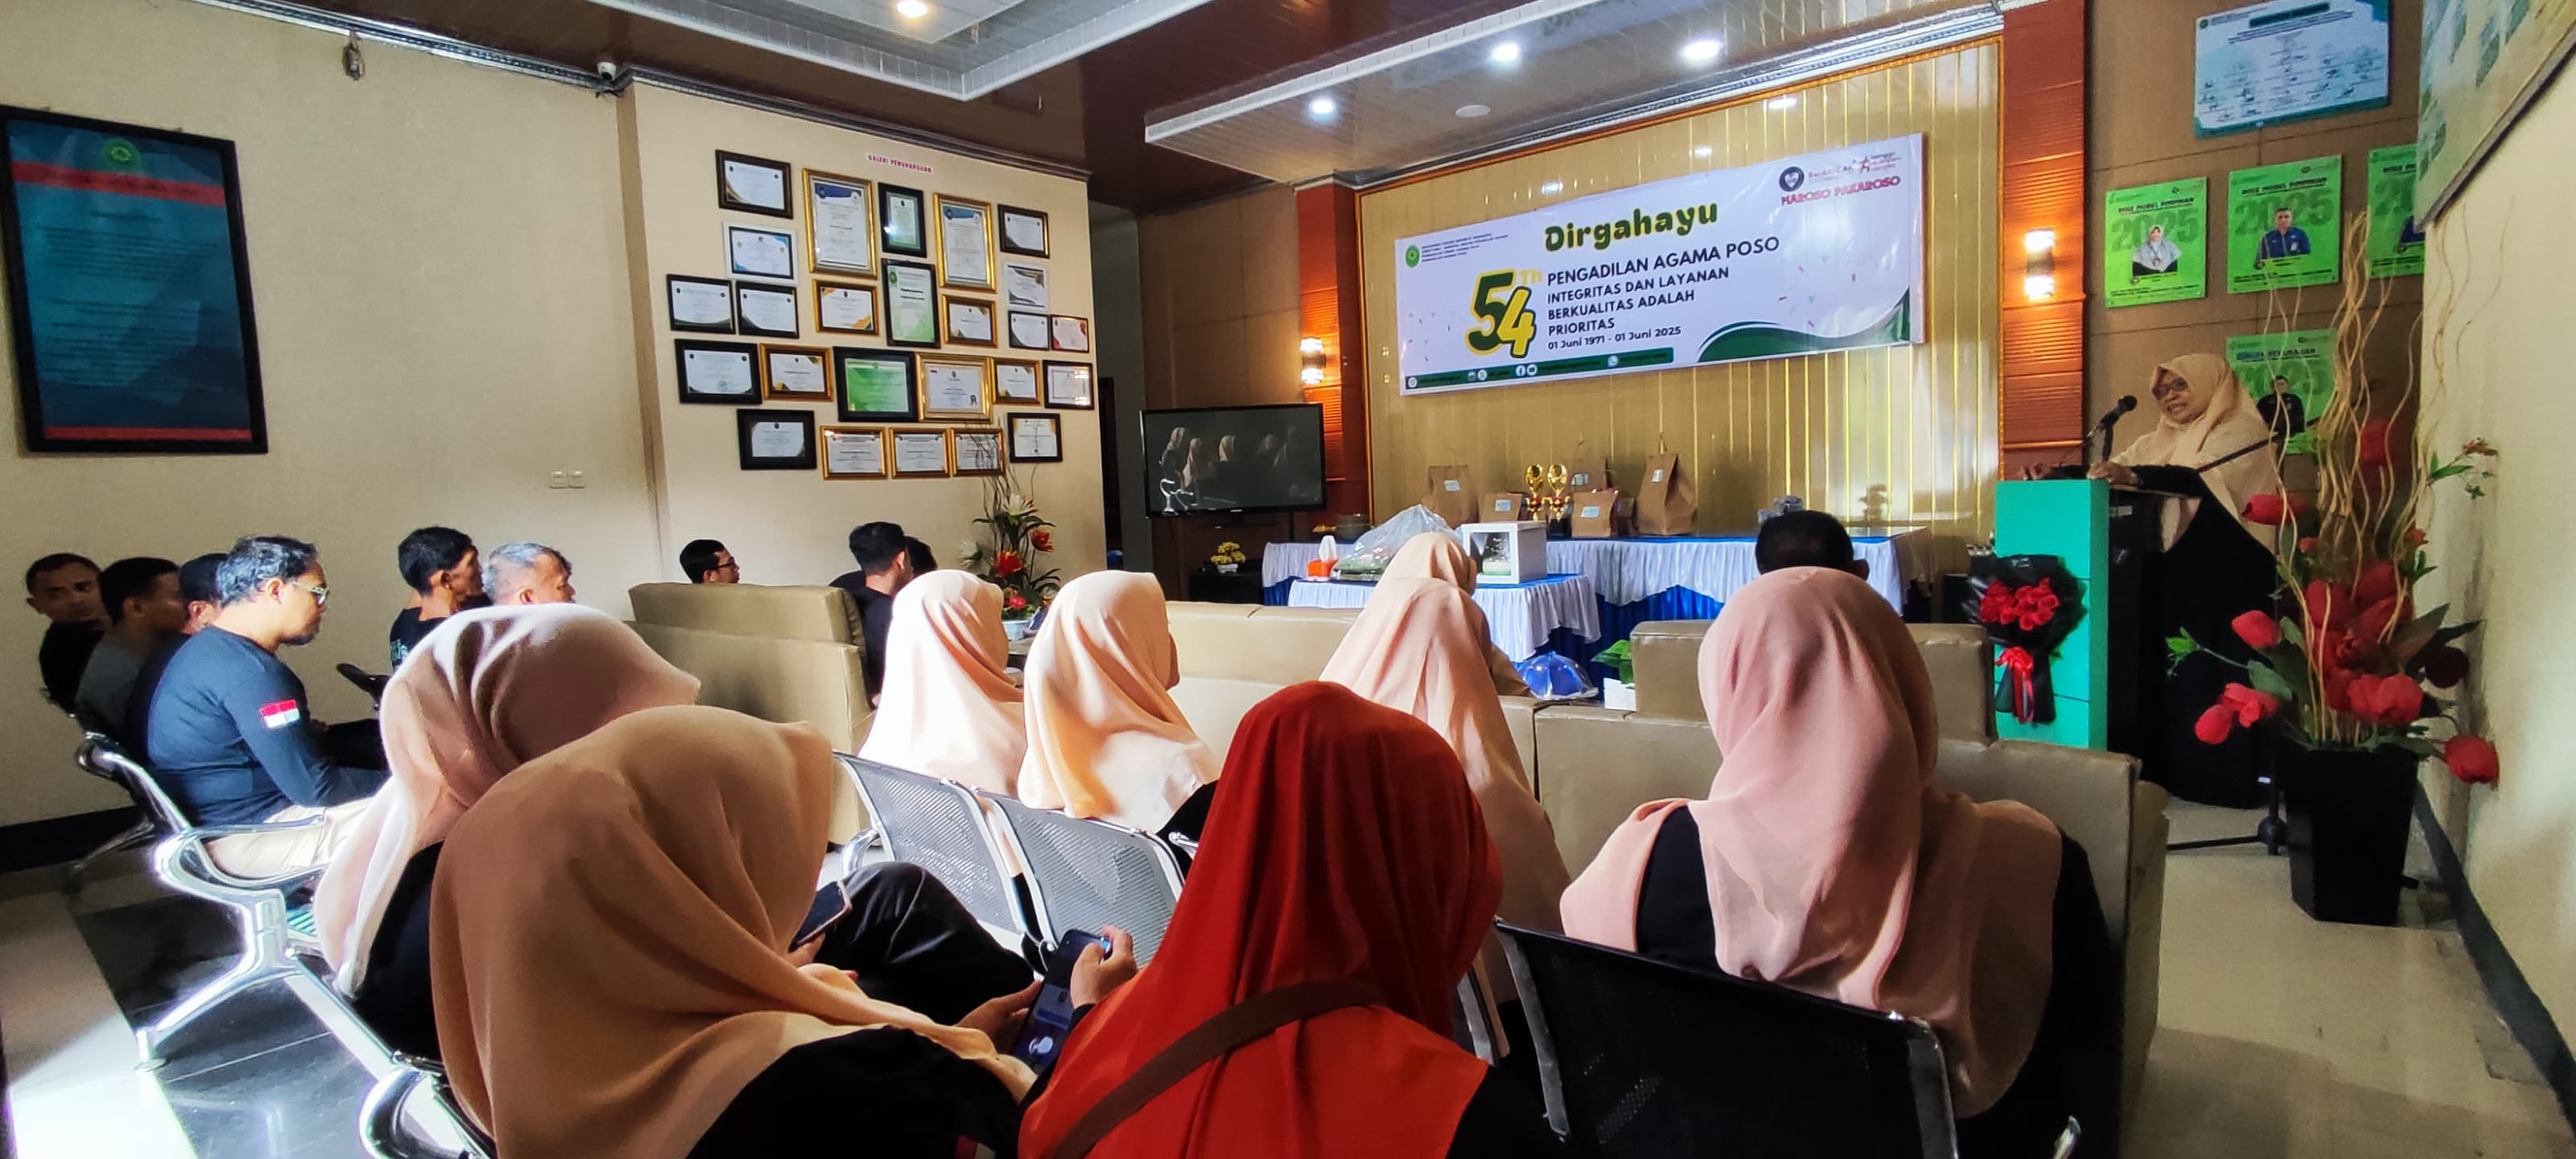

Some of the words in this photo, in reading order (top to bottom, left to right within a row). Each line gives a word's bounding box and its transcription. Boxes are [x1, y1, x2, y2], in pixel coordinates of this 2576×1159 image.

[1544, 203, 1718, 252] Dirgahayu
[1547, 258, 1649, 286] PENGADILAN
[1653, 246, 1721, 270] AGAMA
[1726, 237, 1779, 258] POSO
[1547, 283, 1621, 303] INTEGRITAS
[1625, 278, 1654, 293] DAN
[1659, 266, 1729, 287] LAYANAN
[1464, 268, 1537, 358] 54
[1548, 299, 1633, 320] BERKUALITAS
[1638, 290, 1695, 307] ADALAH
[1547, 341, 1558, 349] 01
[1561, 337, 1582, 349] Juni
[1585, 336, 1605, 346] 1971
[1615, 333, 1625, 342] 01
[1629, 329, 1652, 340] Juni
[1654, 326, 1682, 337] 2025
[1548, 318, 1615, 336] PRIORITAS
